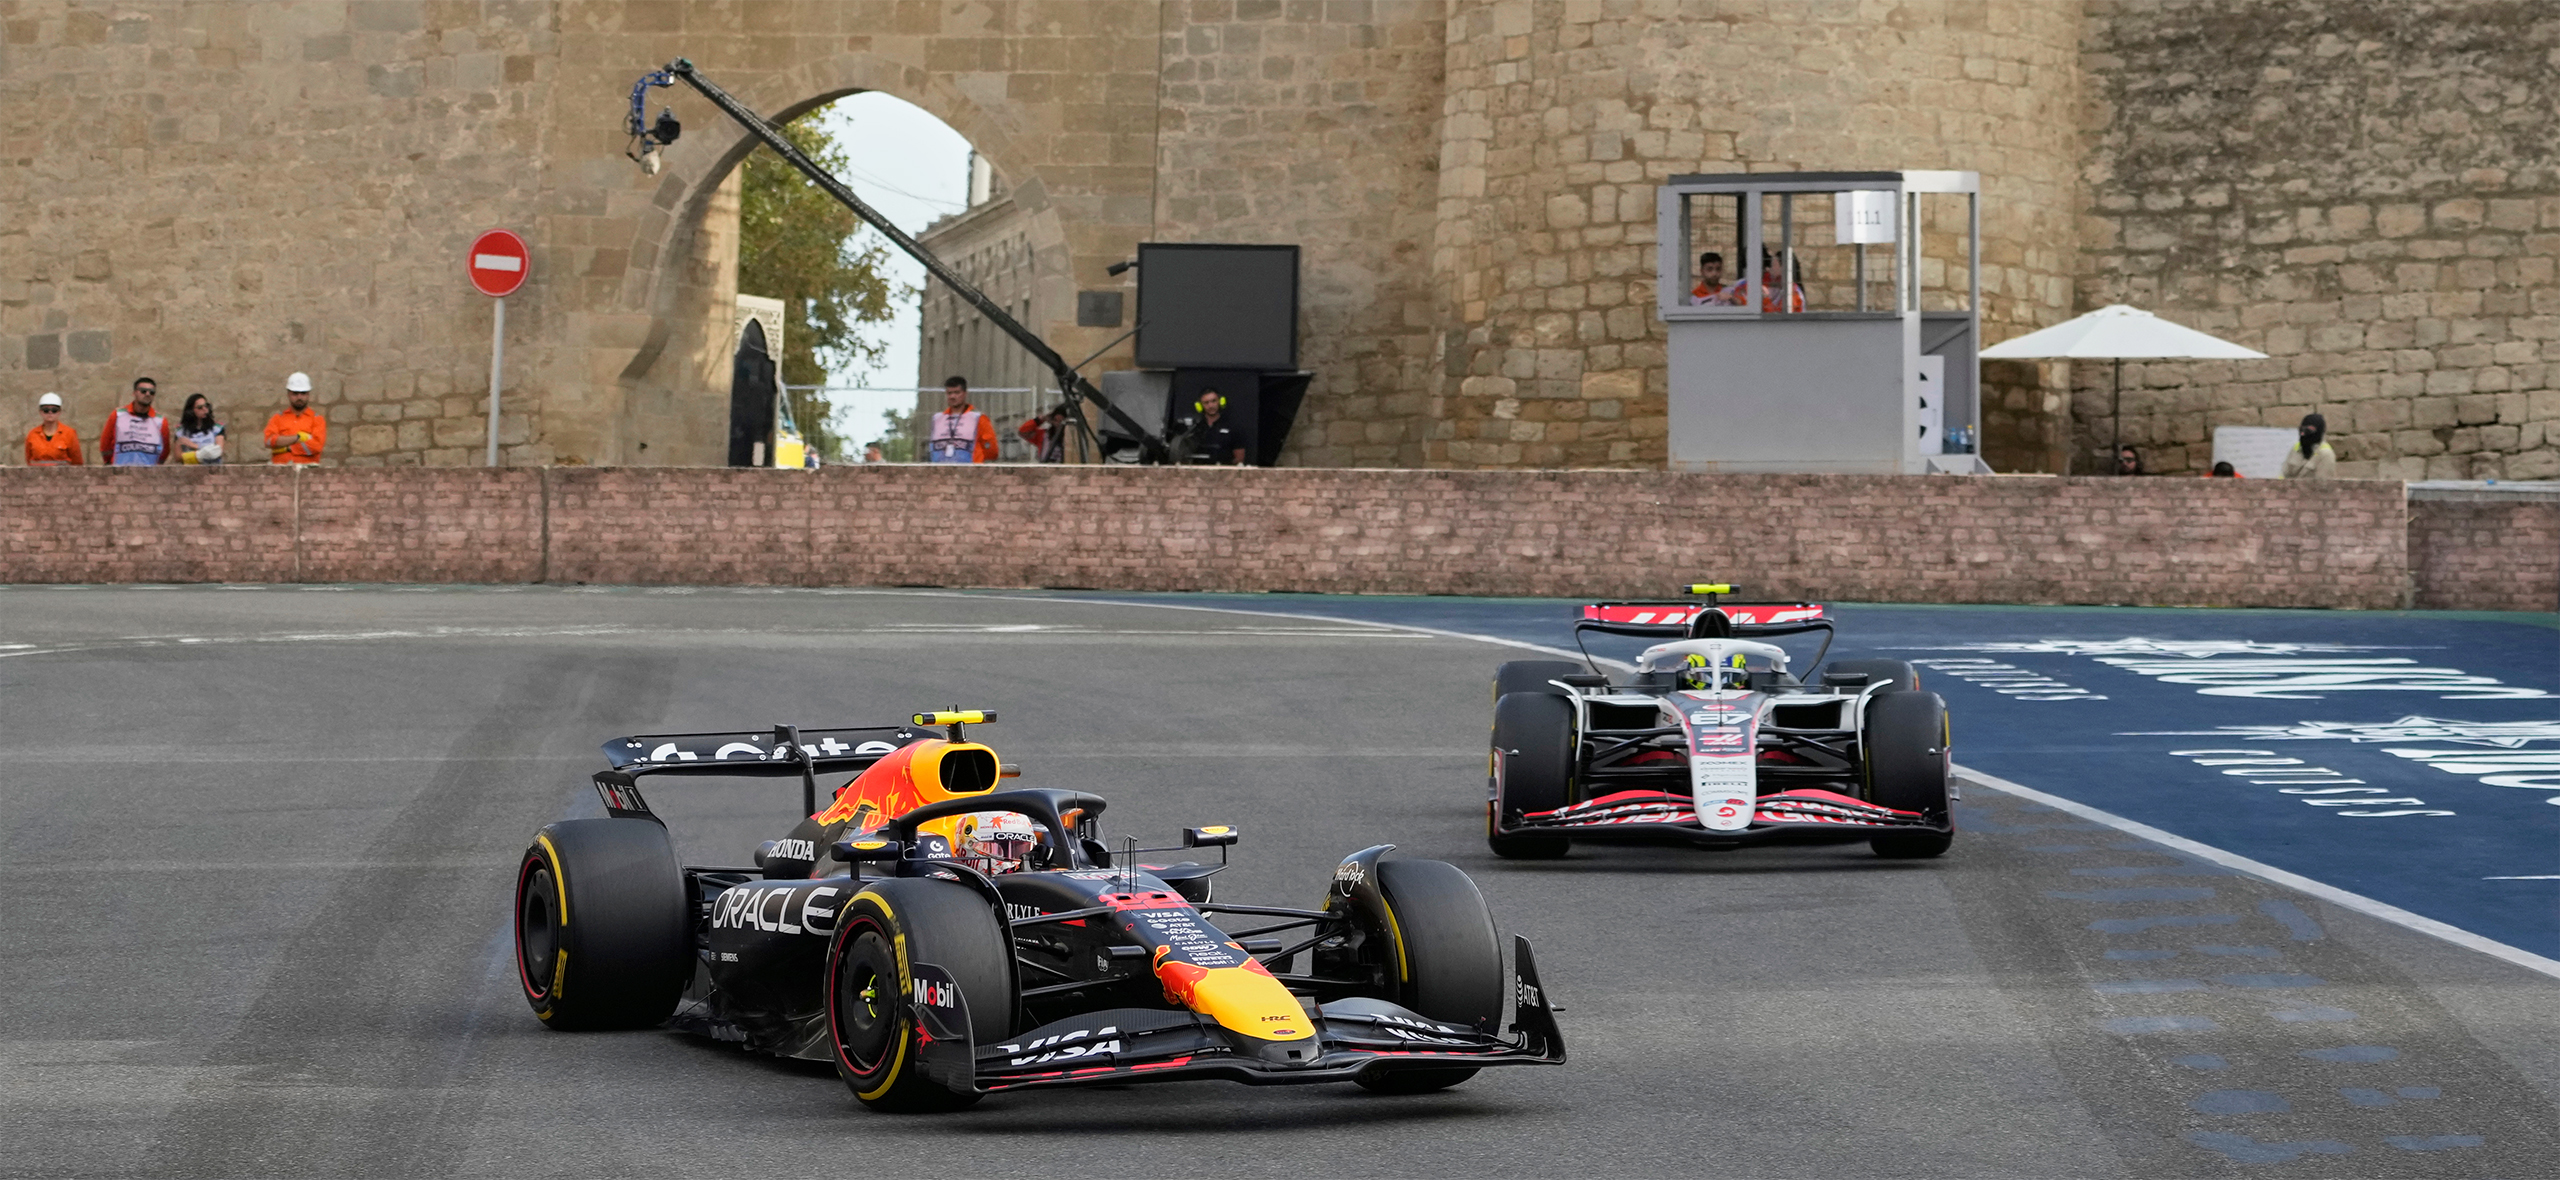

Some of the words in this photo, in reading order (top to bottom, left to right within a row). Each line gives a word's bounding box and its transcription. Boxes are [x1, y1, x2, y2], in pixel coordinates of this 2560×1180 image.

[1690, 713, 1752, 725] 87
[597, 781, 636, 811] Mobil
[2168, 749, 2457, 818] CRUISES
[767, 838, 815, 862] HONDA
[996, 832, 1035, 842] ORACLE
[713, 886, 840, 937] ORACLE
[914, 978, 954, 1009] Mobil
[1522, 983, 1540, 1008] AT&T
[996, 1026, 1121, 1067] VISA
